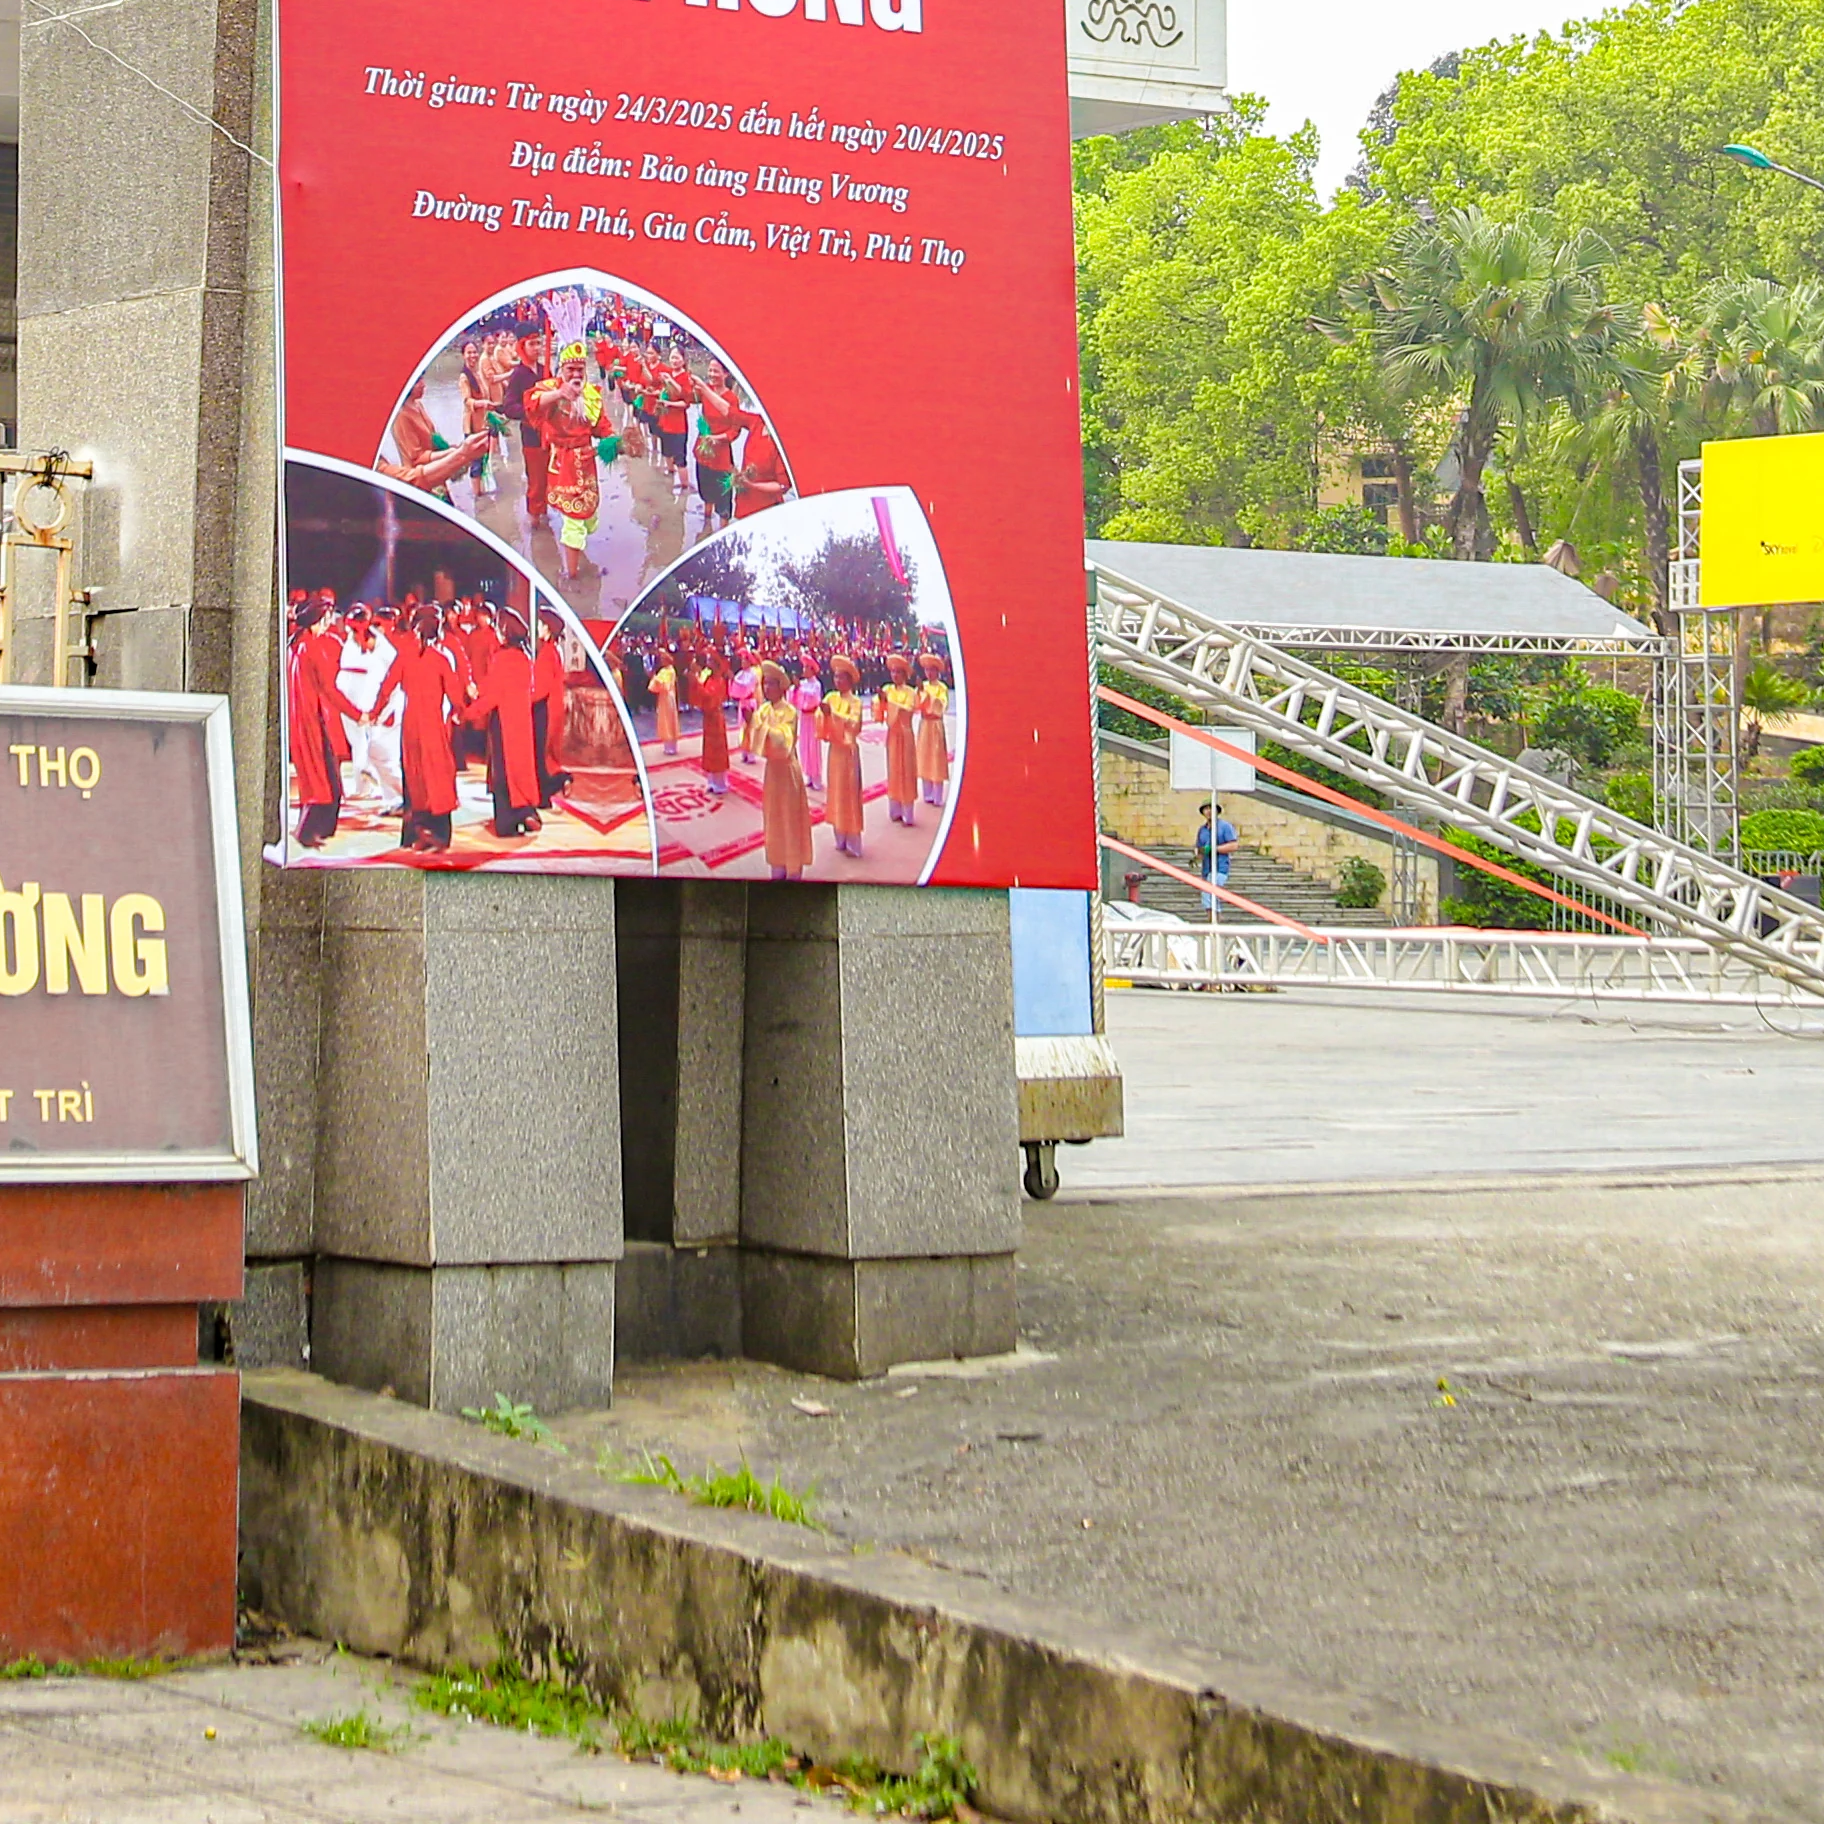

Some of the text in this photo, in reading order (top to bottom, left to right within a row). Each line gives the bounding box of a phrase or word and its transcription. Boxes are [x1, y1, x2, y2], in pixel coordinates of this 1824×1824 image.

[364, 65, 1004, 161] Thời gian: Từ ngày 24/3/2025 đến hết ngày 20/4/2025
[509, 140, 909, 213] Địa điểm: Bảo tàng Hùng Vương
[412, 189, 966, 275] Đường Trần Phú, Gia Cẩm, Việt Trì, Phú Thọ
[9, 743, 102, 800] THỌ
[33, 1081, 94, 1123] TRÌ
